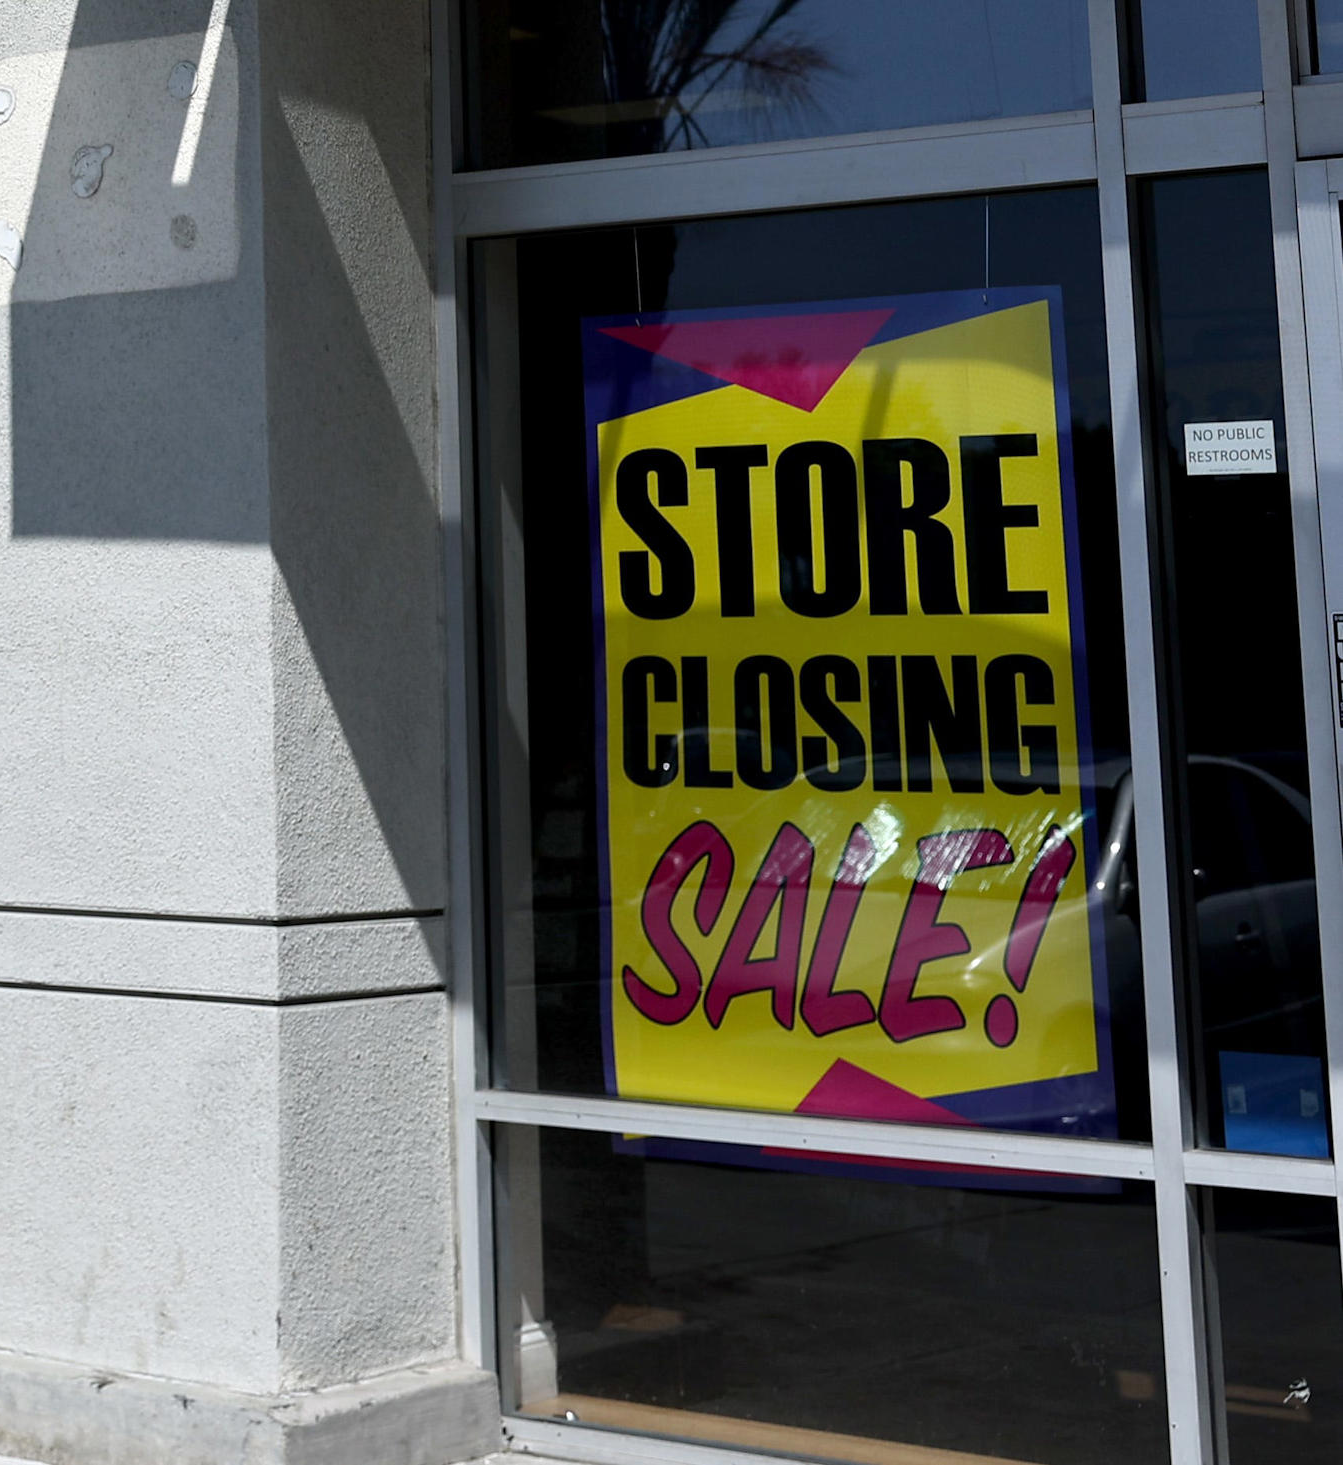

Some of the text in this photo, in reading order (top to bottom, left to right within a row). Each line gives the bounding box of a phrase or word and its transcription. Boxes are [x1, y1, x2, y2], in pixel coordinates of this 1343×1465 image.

[1188, 448, 1273, 463] RESTROOMS
[1192, 427, 1265, 442] NO PUBLIC
[614, 432, 1050, 622] STORE
[619, 653, 1061, 796] CLOSING
[620, 819, 1078, 1049] SALE!
